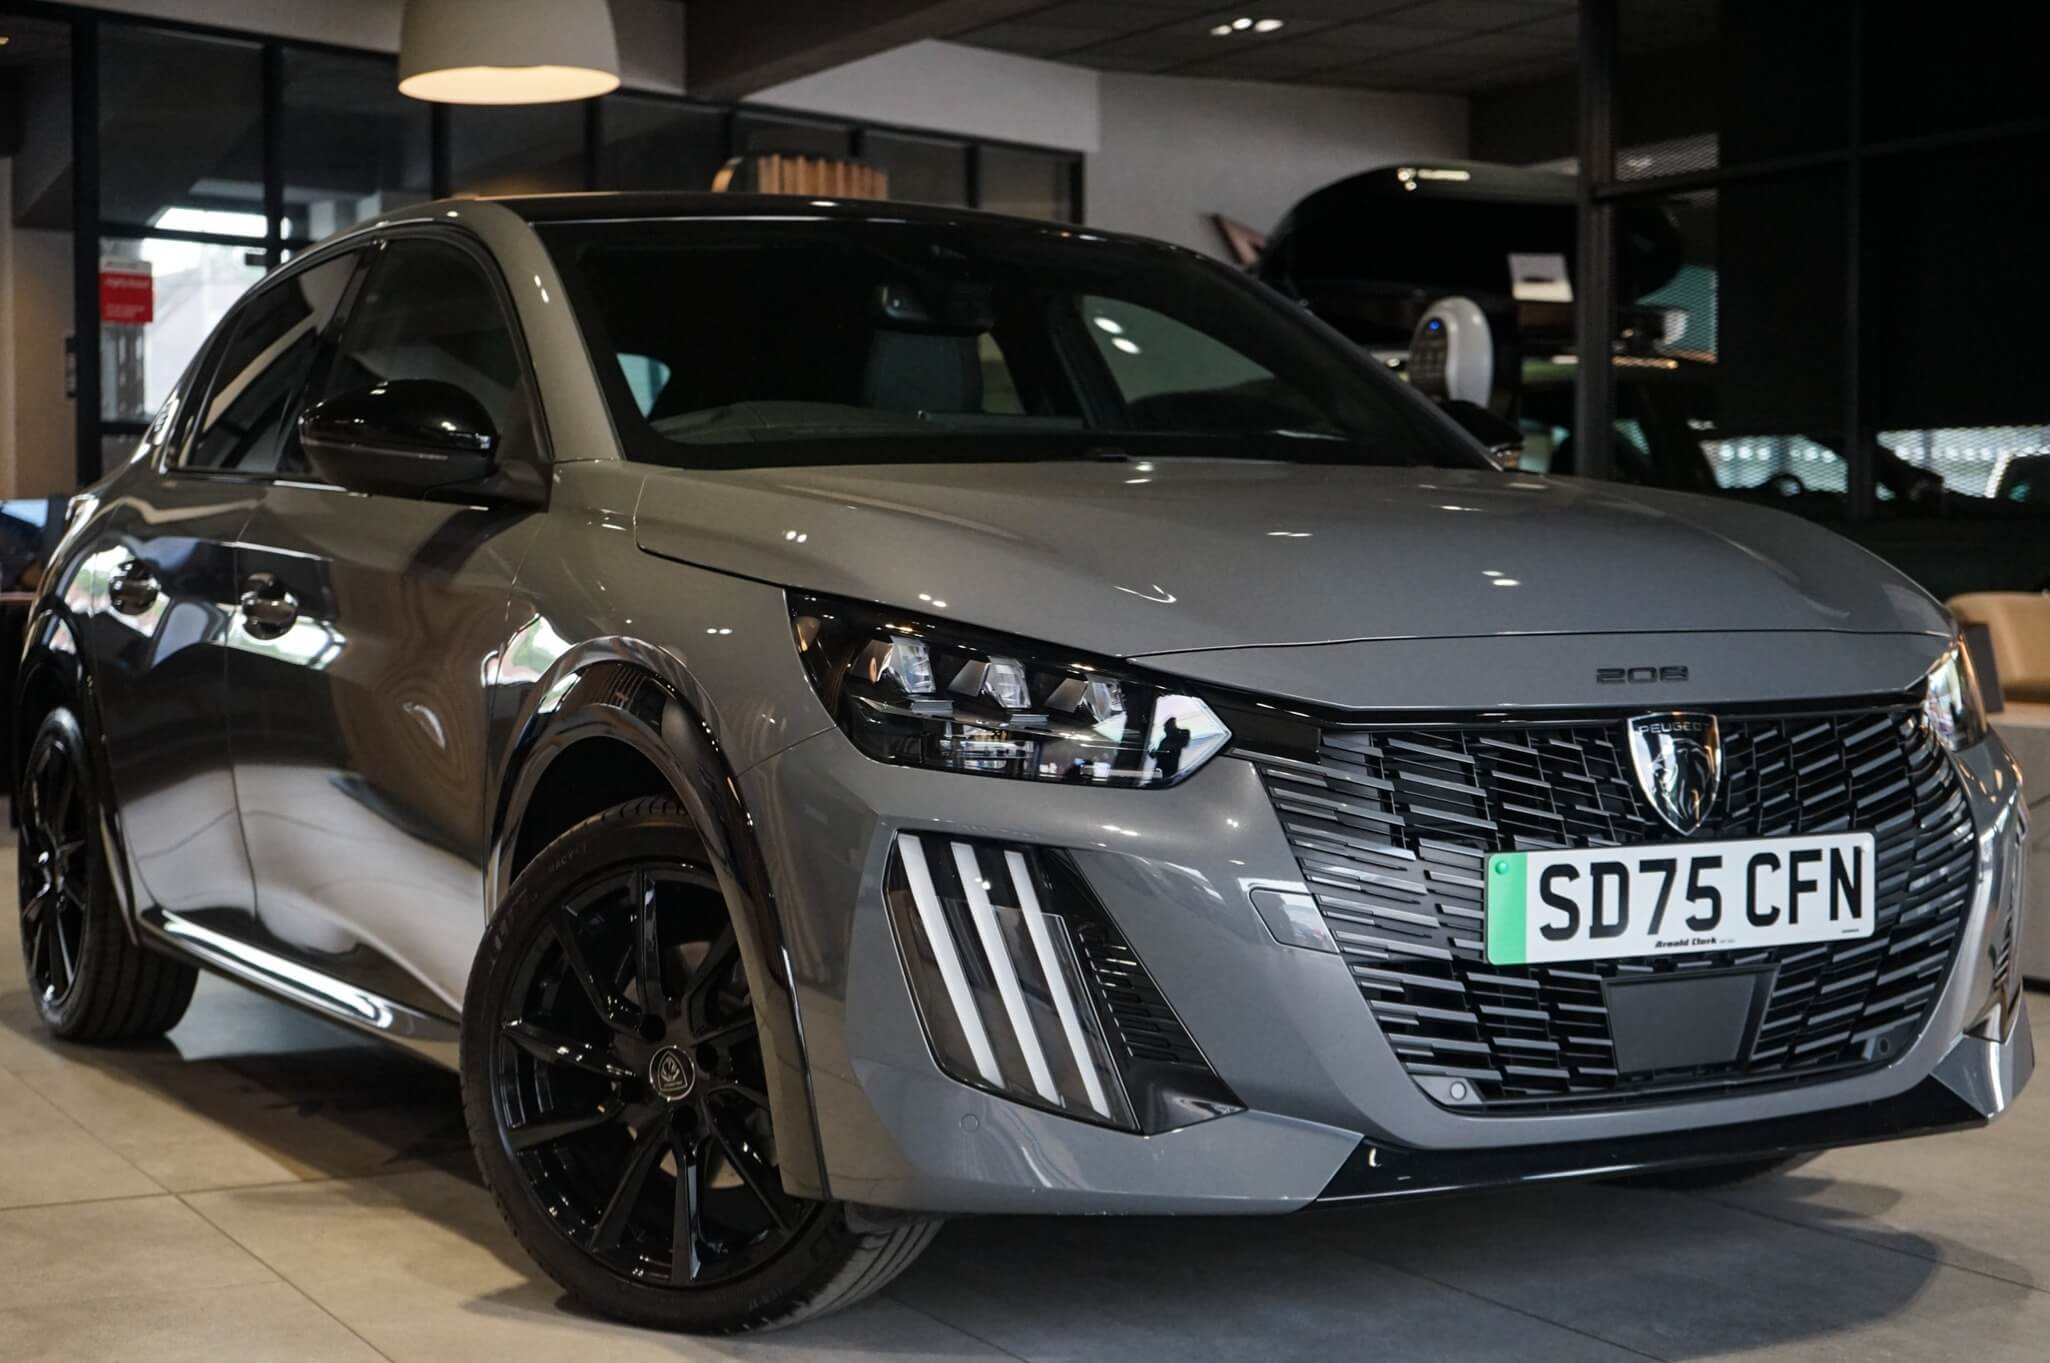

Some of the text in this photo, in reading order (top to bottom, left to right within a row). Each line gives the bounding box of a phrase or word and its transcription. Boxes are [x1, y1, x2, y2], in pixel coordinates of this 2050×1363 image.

[1596, 665, 1689, 684] 208
[1539, 846, 1863, 941] SD75 CFN
[1655, 939, 1689, 948] Arnold
[1692, 937, 1717, 946] Clark
